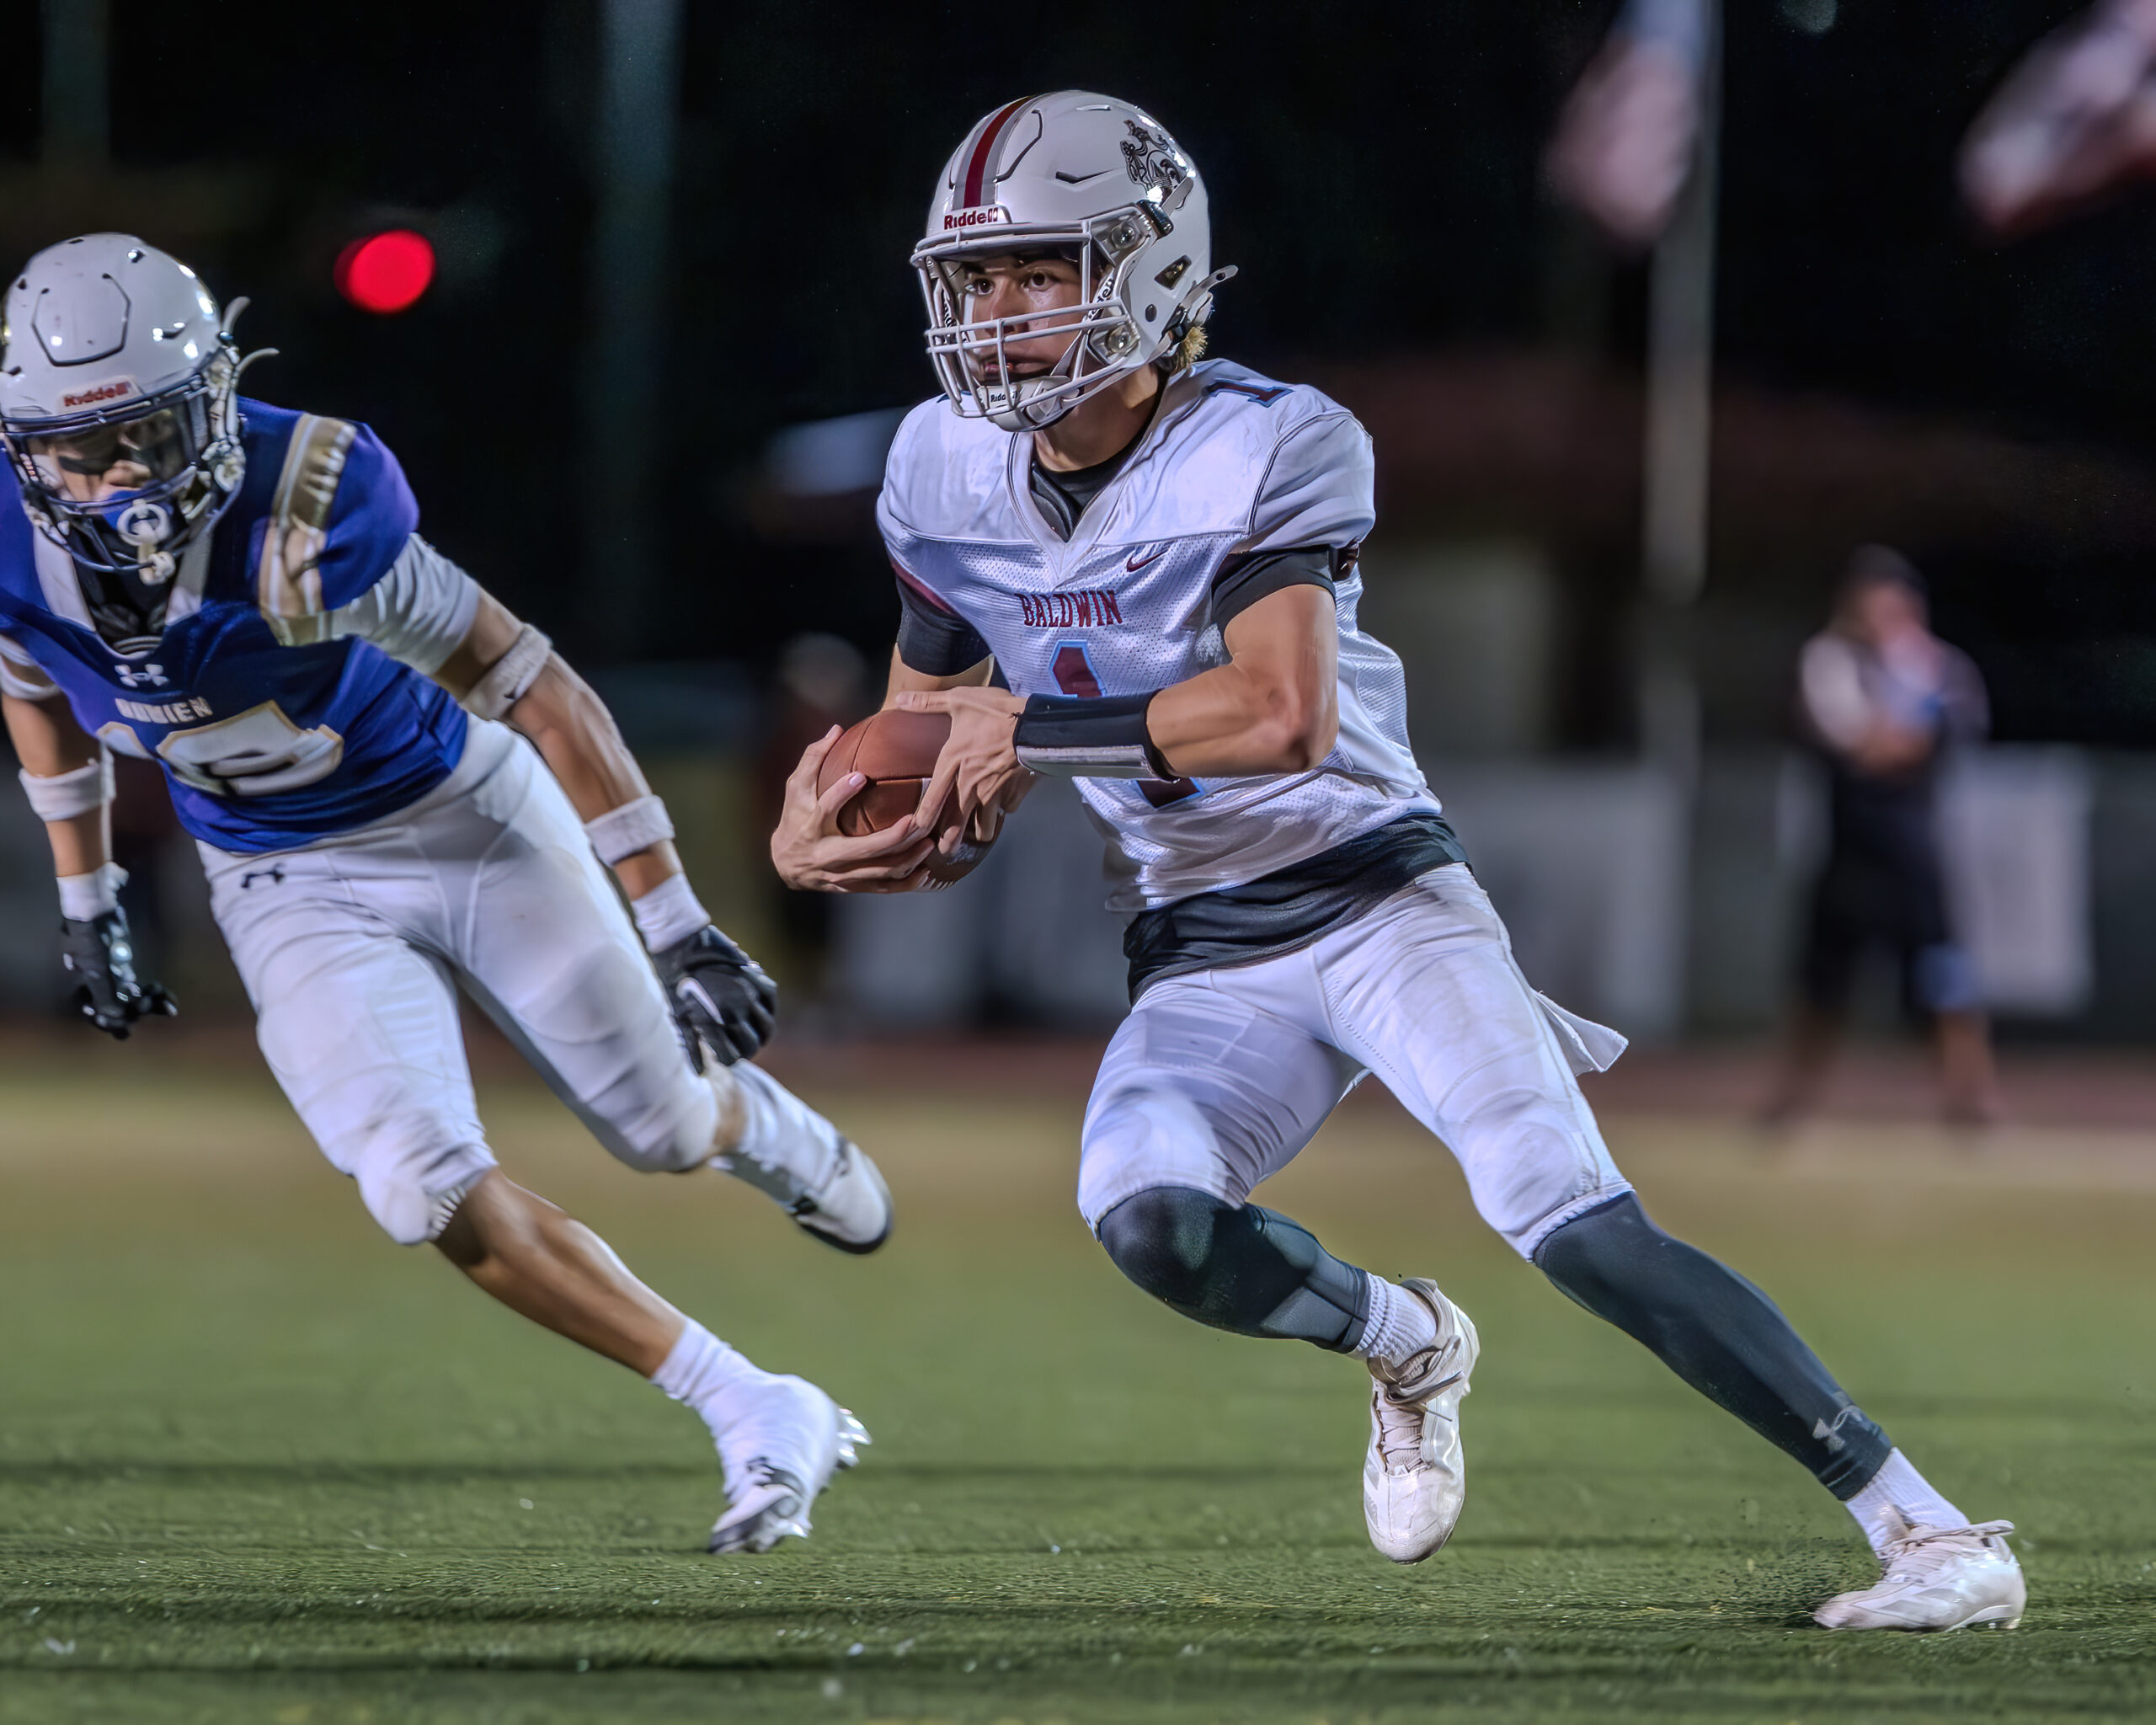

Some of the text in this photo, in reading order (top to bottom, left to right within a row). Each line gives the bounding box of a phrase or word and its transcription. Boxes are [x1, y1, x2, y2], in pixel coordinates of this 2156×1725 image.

[944, 207, 999, 230] Riddell
[990, 391, 1018, 403] Ridd
[1013, 590, 1123, 628] BALDWIN
